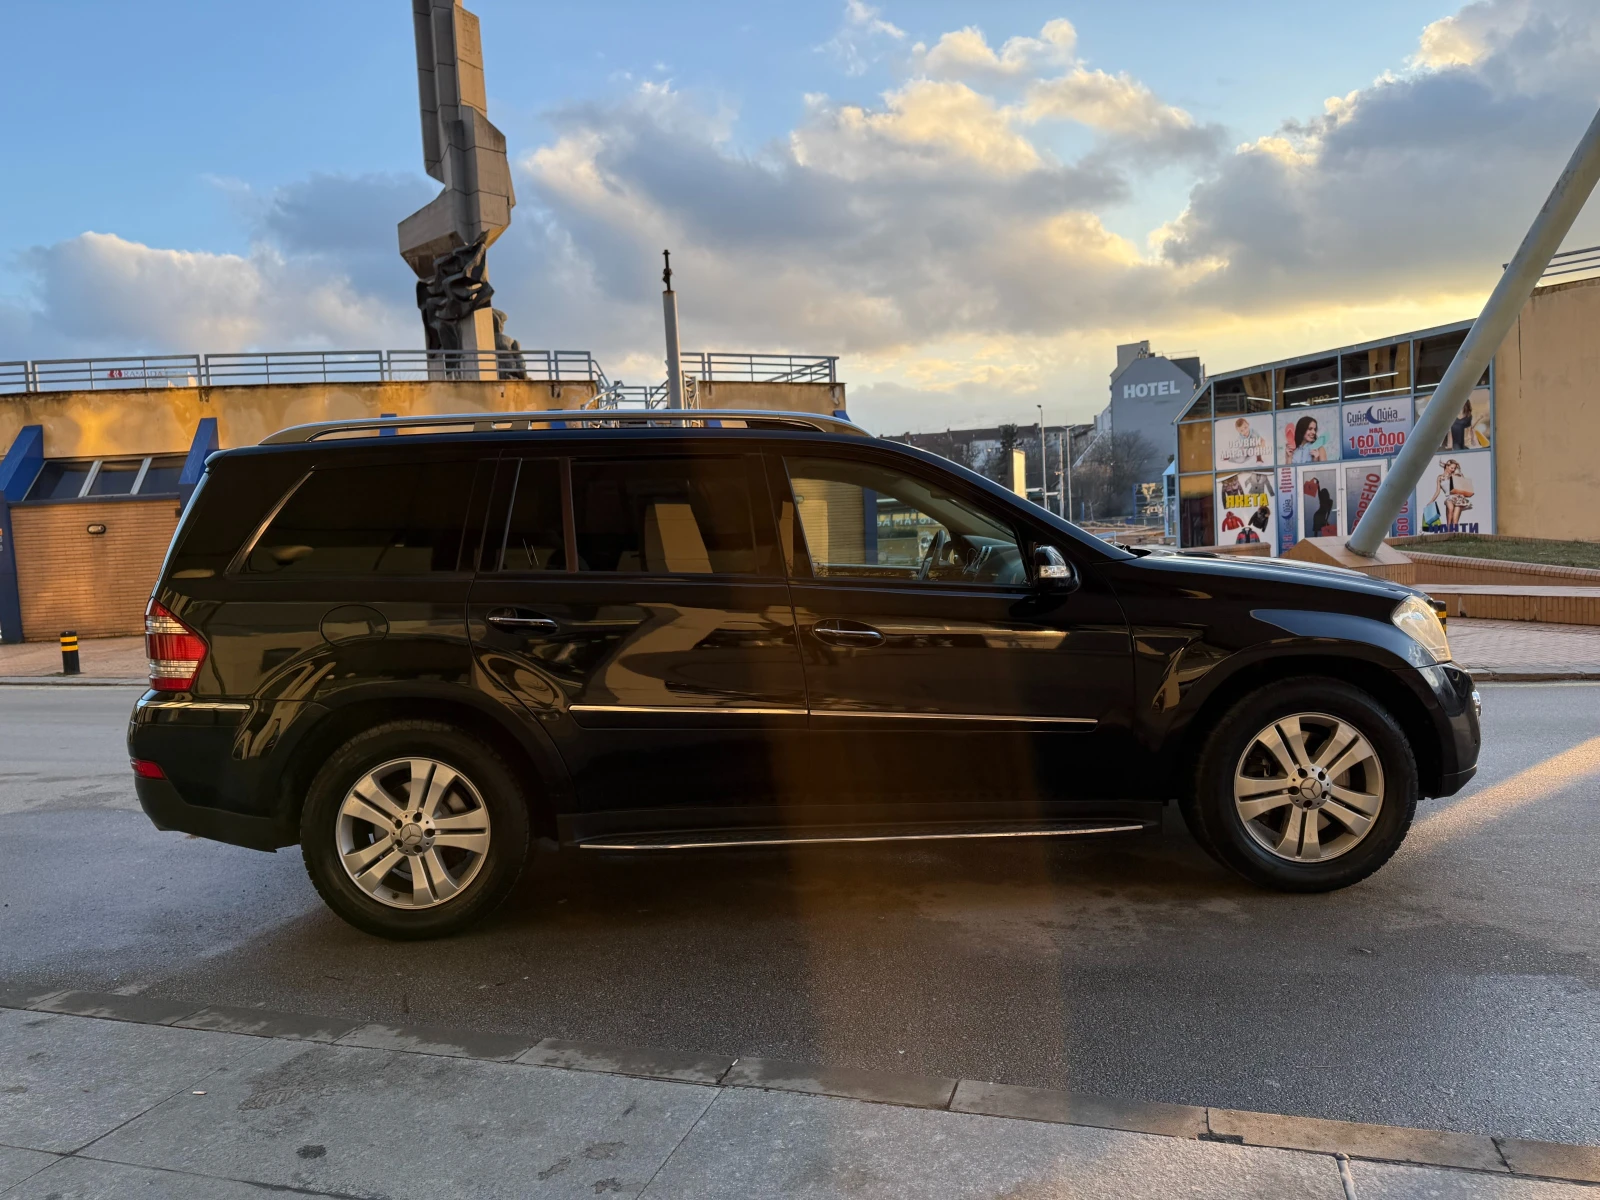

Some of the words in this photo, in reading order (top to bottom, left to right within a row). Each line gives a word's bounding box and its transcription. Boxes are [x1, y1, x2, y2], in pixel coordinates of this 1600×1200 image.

[1124, 380, 1180, 399] HOTEL
[1349, 435, 1374, 449] 160
[1378, 431, 1405, 447] 000
[1360, 446, 1394, 456] артикула
[1226, 493, 1269, 508] ЯКЕТА
[1429, 522, 1479, 534] ЧАНТИ
